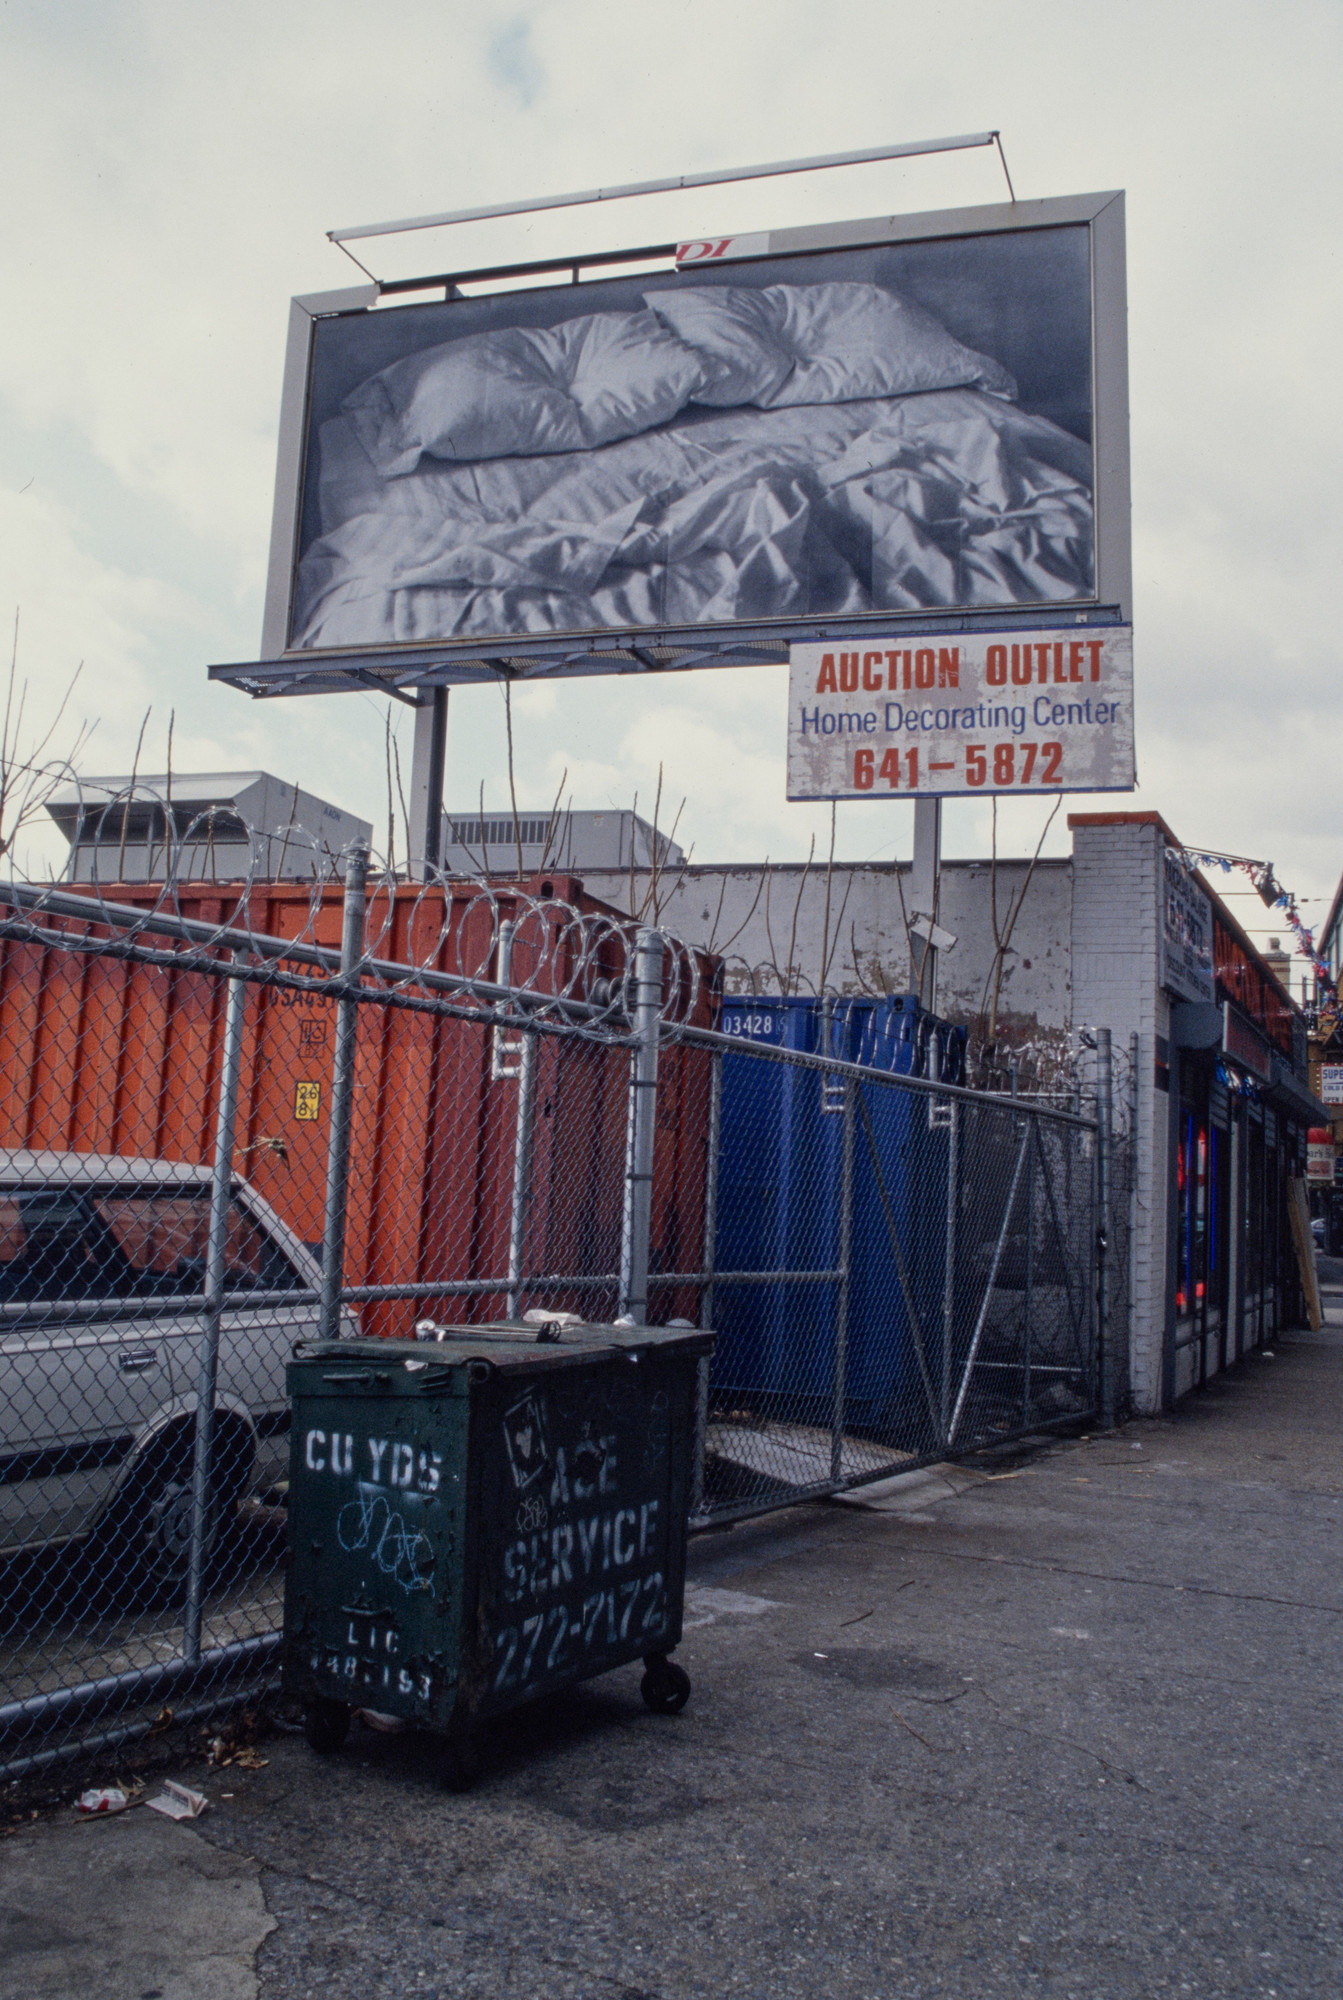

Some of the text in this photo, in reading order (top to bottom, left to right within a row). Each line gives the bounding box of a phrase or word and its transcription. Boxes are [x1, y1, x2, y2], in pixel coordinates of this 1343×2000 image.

[815, 640, 1104, 694] AUCTION OUTLET
[801, 696, 1121, 735] Home Decorating Center
[853, 741, 1064, 790] 641-5872
[723, 1015, 772, 1035] 03428
[306, 1429, 443, 1492] CU YDS
[504, 1500, 659, 1602] SERVICE
[348, 1622, 399, 1653] LIC
